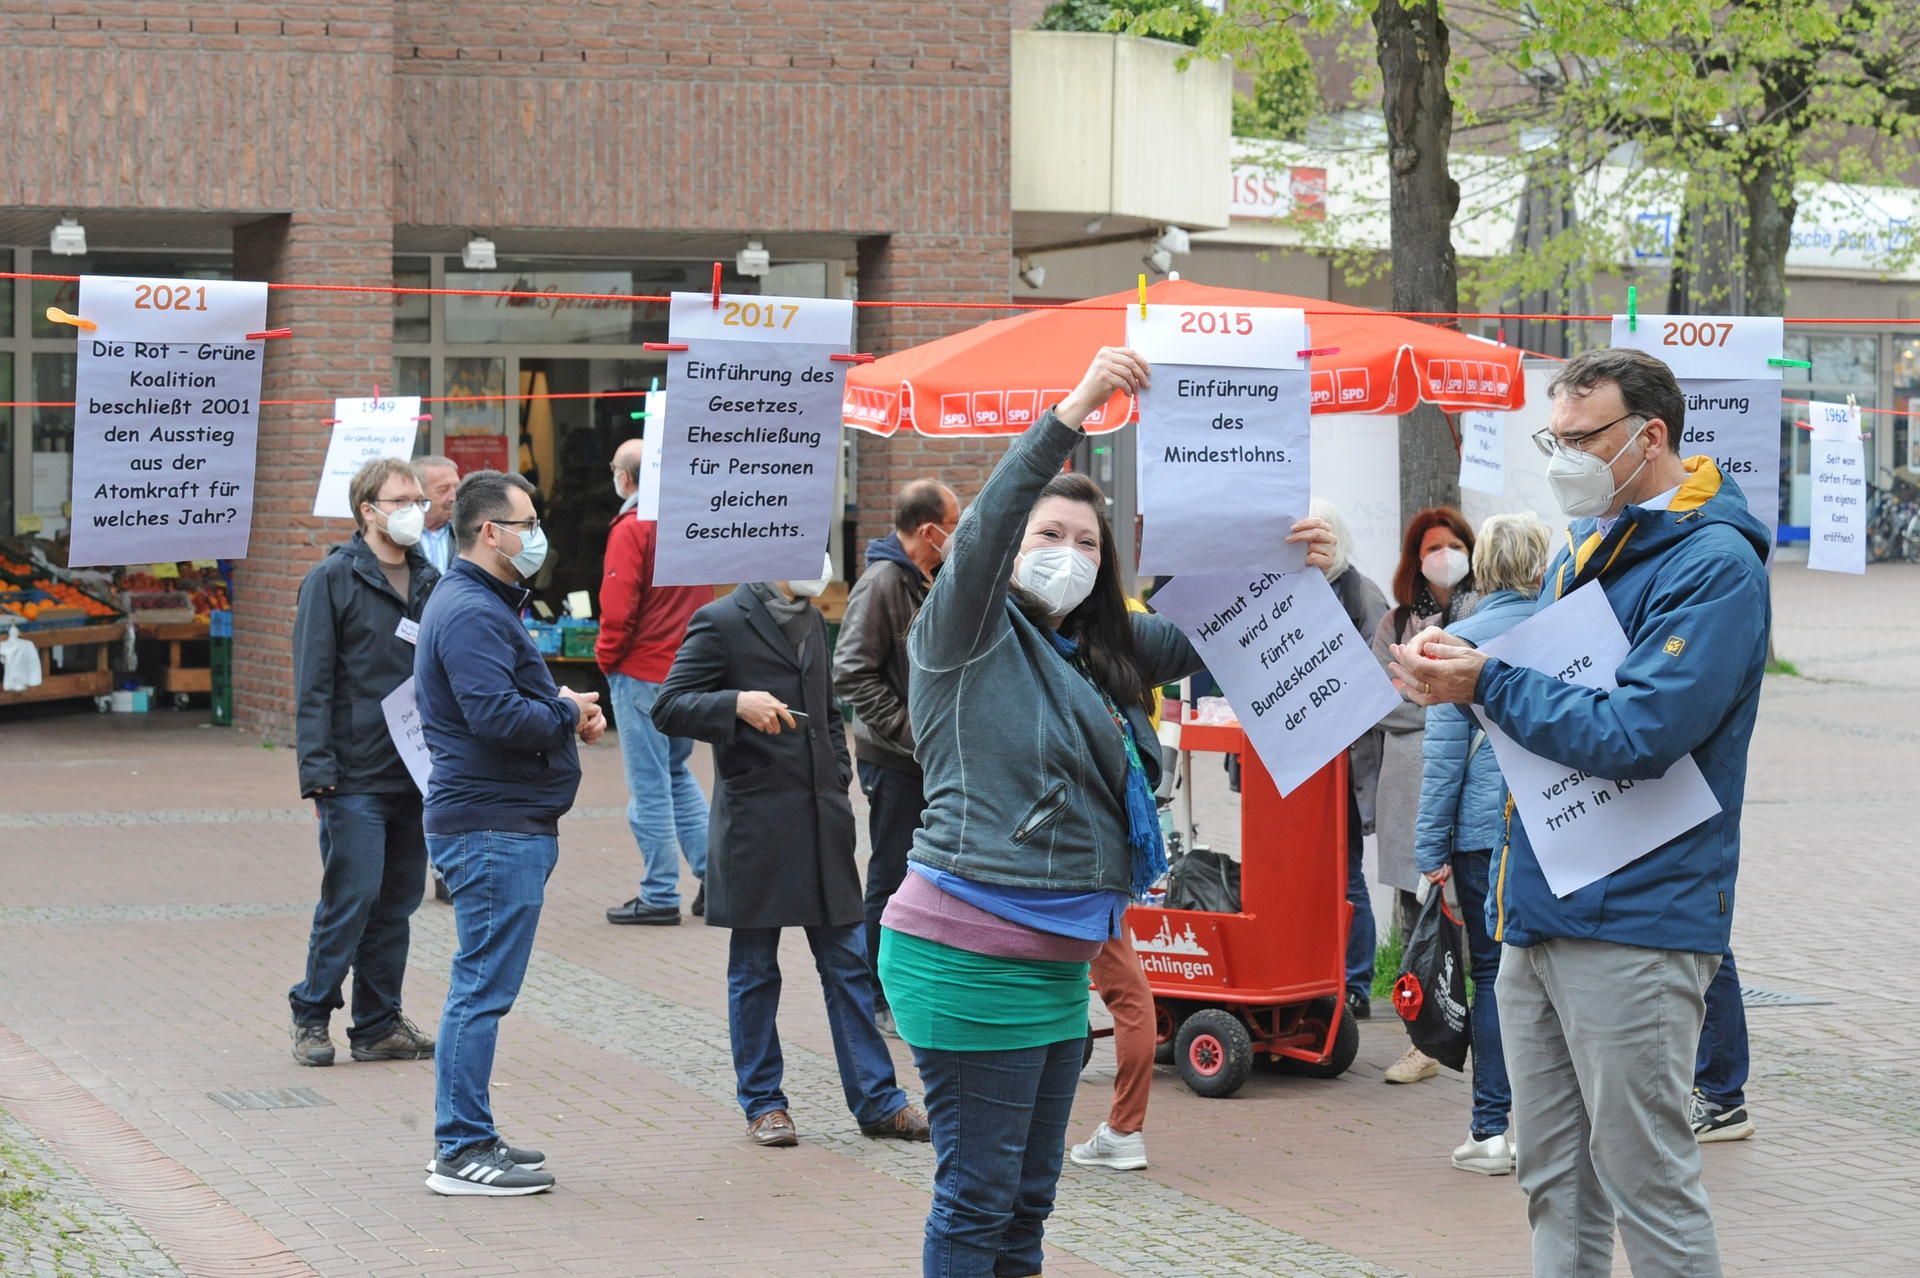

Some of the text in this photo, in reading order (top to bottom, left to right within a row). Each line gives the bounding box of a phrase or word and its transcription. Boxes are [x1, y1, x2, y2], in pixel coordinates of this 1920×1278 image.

[135, 285, 207, 311] 2021
[722, 302, 798, 329] 2017
[1181, 312, 1252, 335] 2015
[1664, 323, 1733, 347] 2007
[93, 341, 124, 357] Die
[135, 342, 169, 359] Rot
[198, 344, 255, 360] Grüne
[131, 371, 215, 387] Koalition
[687, 362, 833, 386] Einführung des
[1179, 380, 1278, 401] Einführung
[1341, 388, 1366, 400] SPD
[90, 398, 249, 415] beschließt 2001
[361, 401, 395, 413] 1949
[709, 396, 803, 415] Gesetzes,
[1683, 393, 1749, 414] ührung
[943, 412, 967, 427] SPD
[975, 409, 999, 424] SPD
[1007, 408, 1030, 423] SPD
[1212, 413, 1243, 429] des
[1824, 408, 1848, 423] 1962
[105, 426, 234, 446] den Ausstieg
[344, 433, 385, 444] Gründung
[688, 427, 820, 448] Eheschließung
[1684, 427, 1714, 442] des
[131, 454, 206, 470] aus der
[1165, 446, 1291, 462] Mindestlohns.
[1826, 454, 1840, 465] Seit
[690, 458, 813, 475] für Personen
[1818, 474, 1862, 486] dürfen Frauen
[94, 481, 239, 499] Atomkraft für
[711, 490, 787, 511] gleichen
[94, 508, 236, 527] welches Jahr?
[686, 522, 804, 539] Geschlechts.
[1196, 572, 1282, 643] Helmut Sch
[1238, 594, 1294, 649] wird der
[1260, 626, 1305, 671] fünfte
[1250, 631, 1345, 718] Bundeskanzler
[1553, 656, 1593, 682] rste
[1284, 677, 1348, 732] der BRD.
[1545, 799, 1587, 832] tritt
[1591, 789, 1612, 806] in
[1138, 954, 1214, 980] ichlingen
